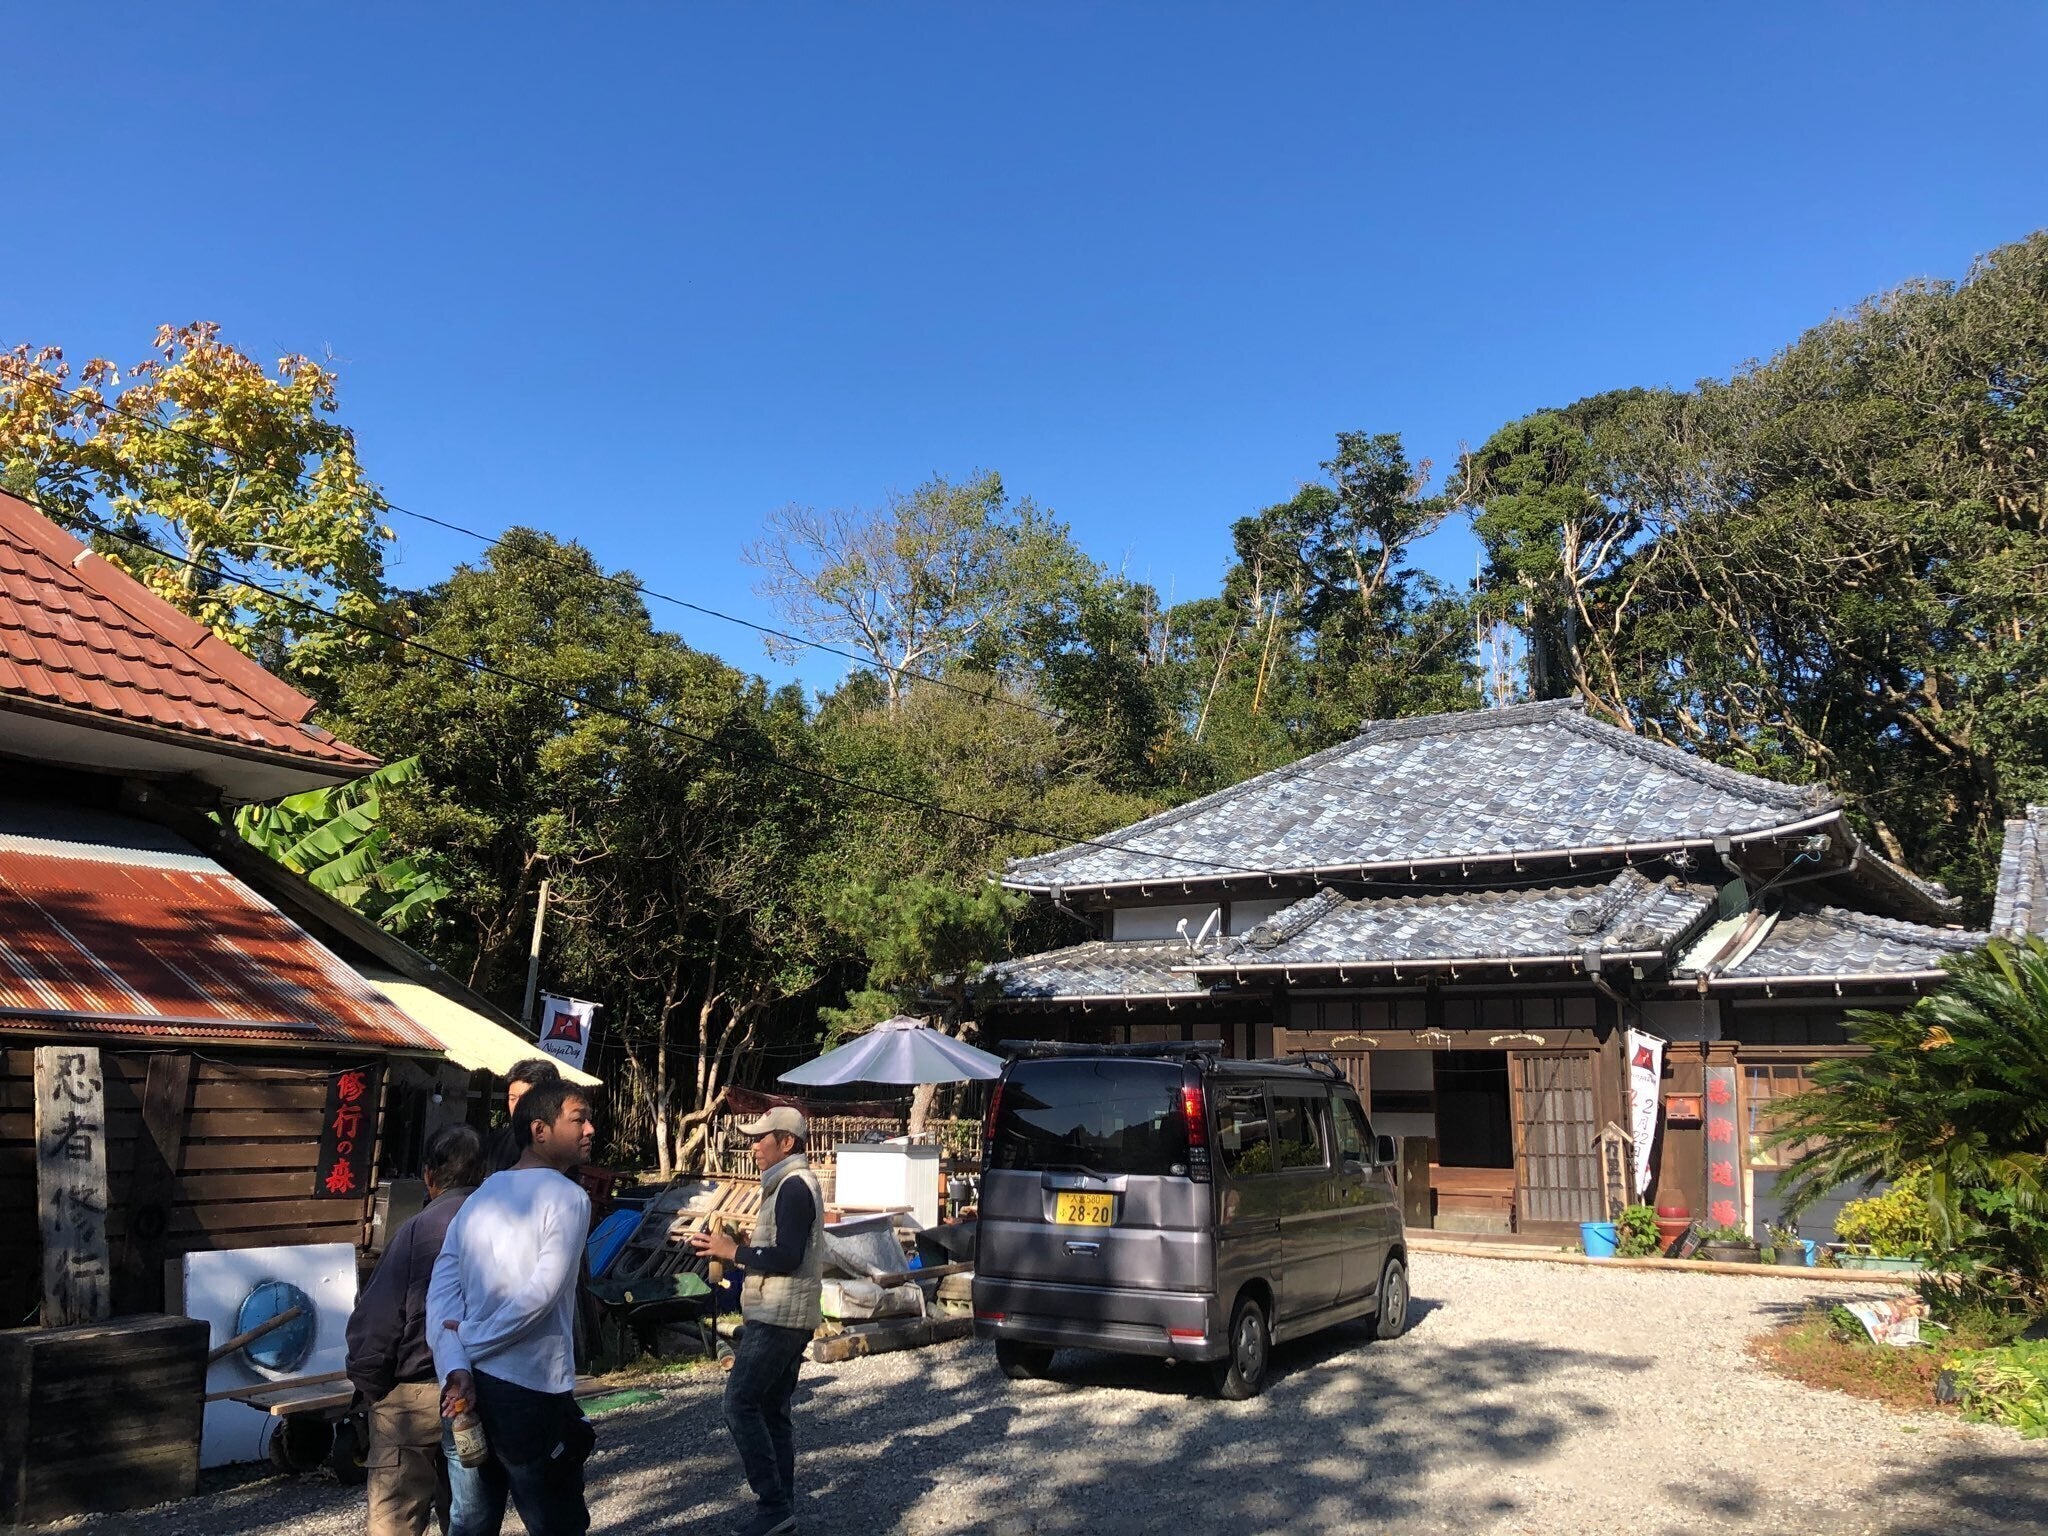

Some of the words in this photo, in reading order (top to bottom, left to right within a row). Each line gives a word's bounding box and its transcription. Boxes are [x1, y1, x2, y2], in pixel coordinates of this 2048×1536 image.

[40, 1053, 106, 1318] 忍者修行
[325, 1072, 367, 1193] 修行の森
[1068, 1205, 1109, 1223] 28-20
